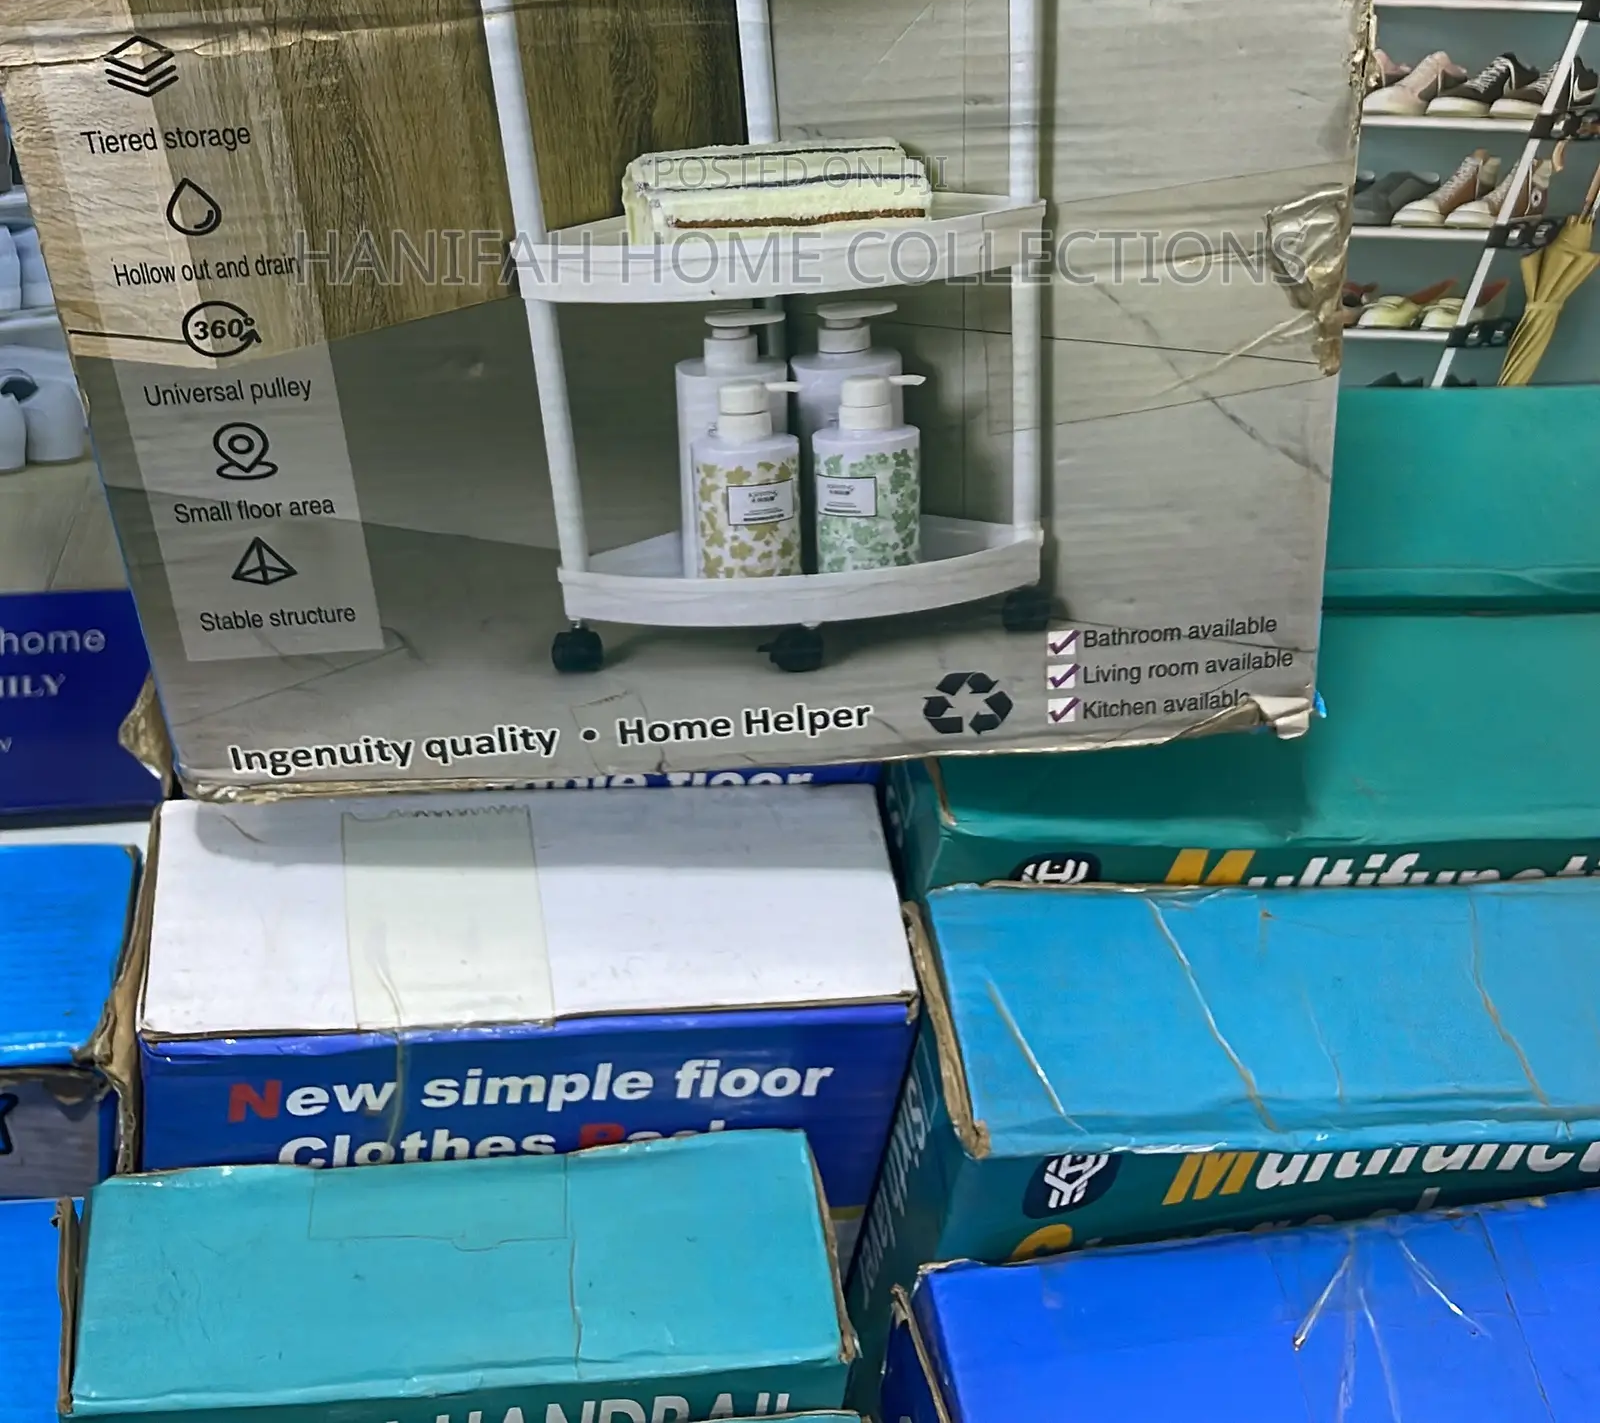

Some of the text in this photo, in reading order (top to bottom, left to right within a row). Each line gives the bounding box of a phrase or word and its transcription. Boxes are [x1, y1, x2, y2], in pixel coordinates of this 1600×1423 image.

[81, 126, 251, 154] Tiered storage
[113, 253, 301, 286] Hollow out and drain
[143, 376, 312, 407] Universal pulley
[174, 497, 336, 524] Small floor area
[199, 606, 357, 632] Stable structure
[1082, 616, 1278, 648] Bathroom available
[1082, 649, 1294, 685] Living room available
[1082, 696, 1157, 720] Kitchen
[230, 702, 871, 776] Ingenuity quality Home Helper
[227, 1078, 398, 1123] New
[421, 1062, 655, 1114] simple
[278, 1130, 557, 1169] Clothes
